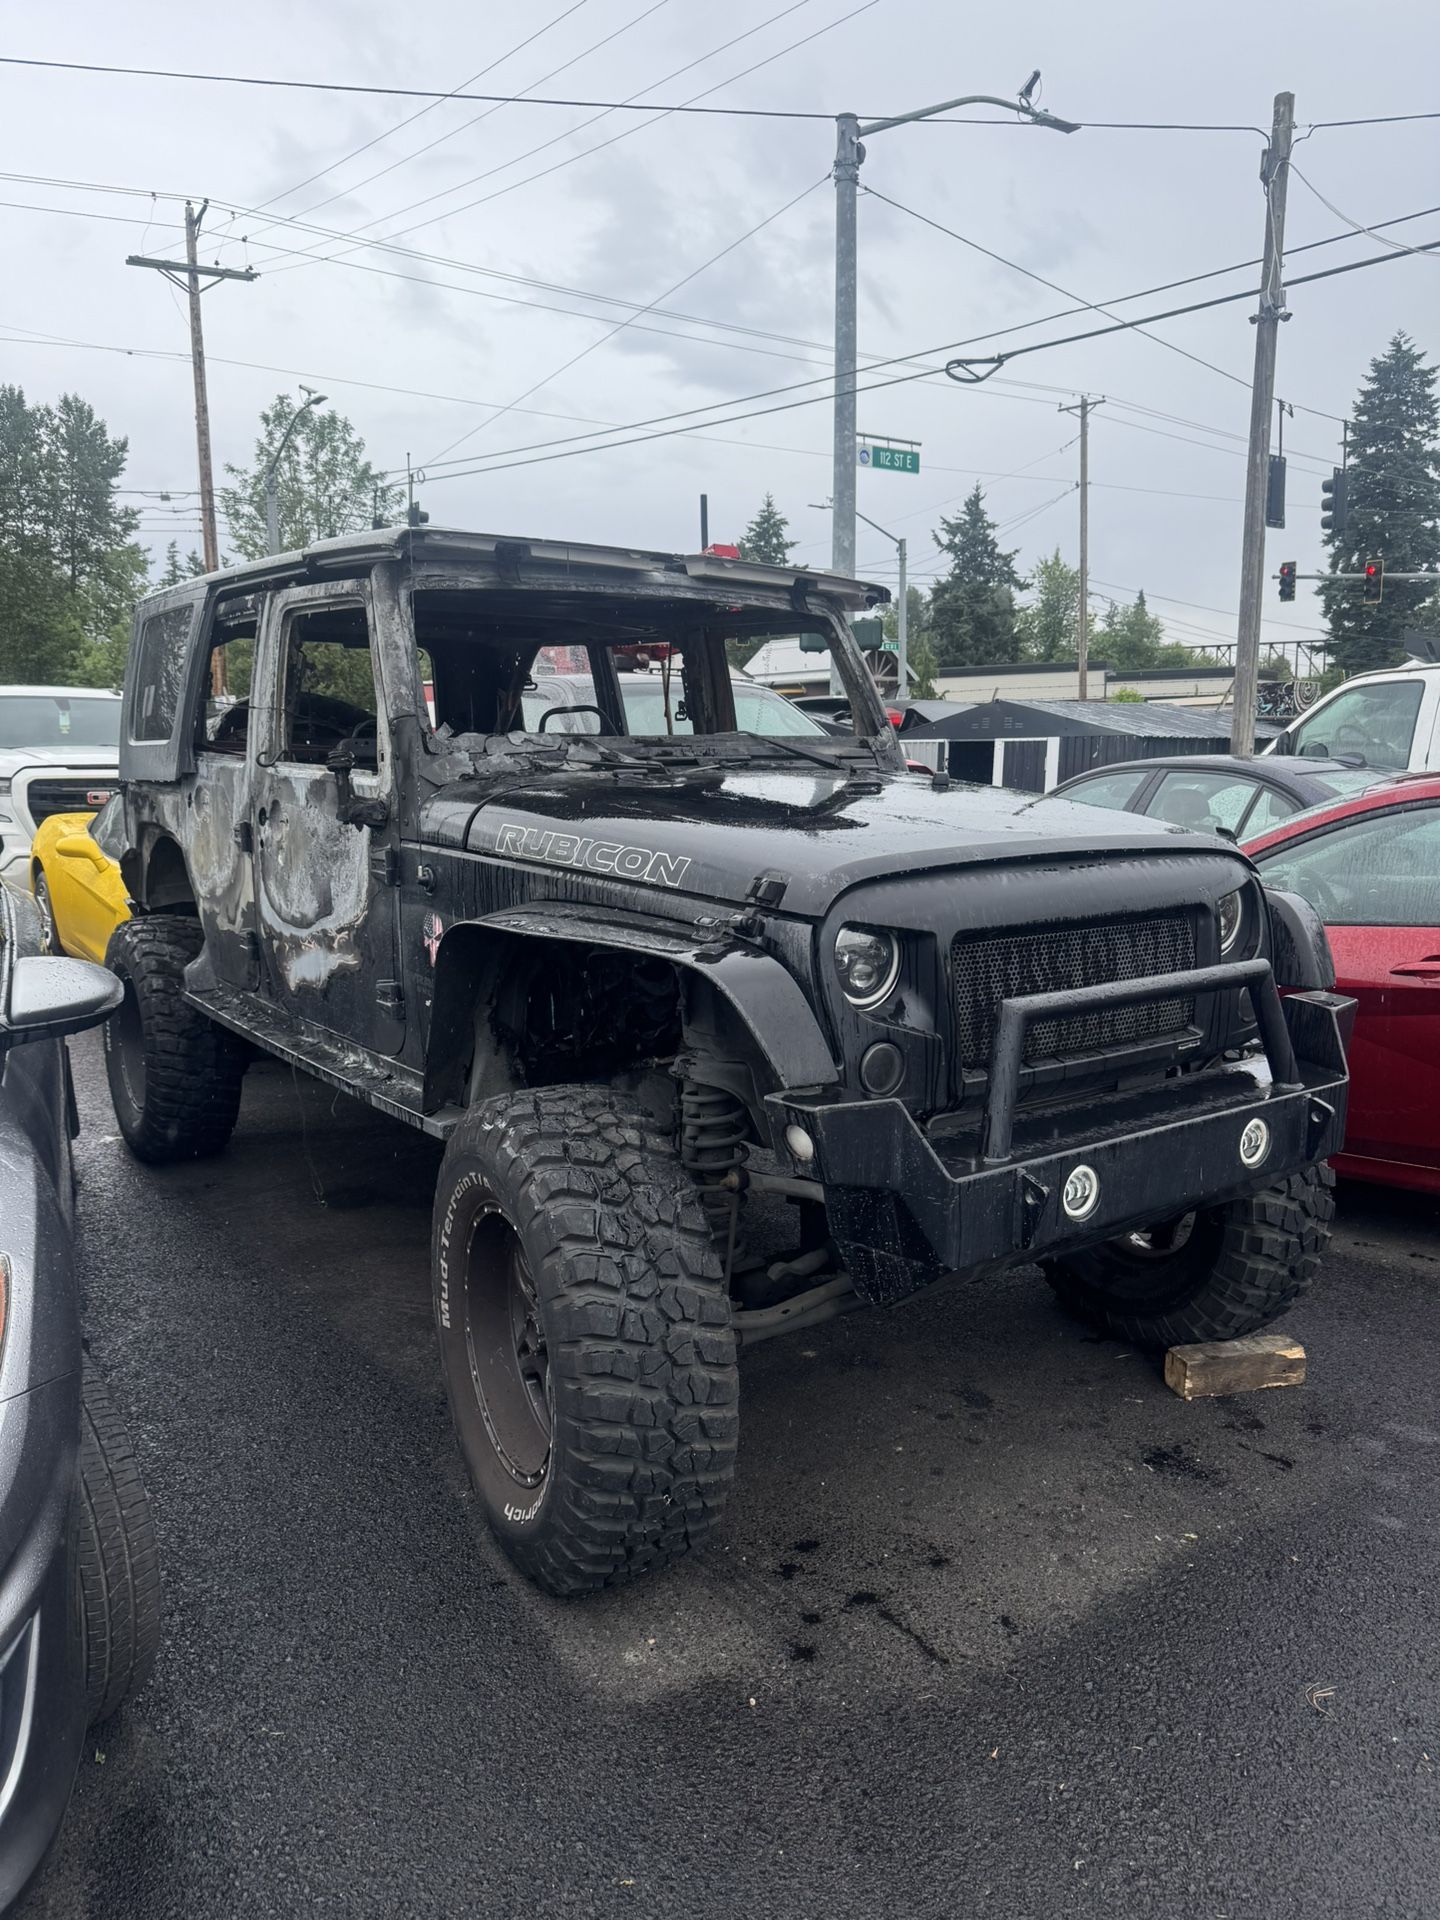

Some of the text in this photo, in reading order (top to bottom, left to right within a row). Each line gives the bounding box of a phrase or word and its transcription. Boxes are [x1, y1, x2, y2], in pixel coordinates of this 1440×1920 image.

[880, 451, 912, 469] 112 ST E
[495, 824, 692, 887] RUBICON
[440, 1175, 473, 1329] Mud-Terrain
